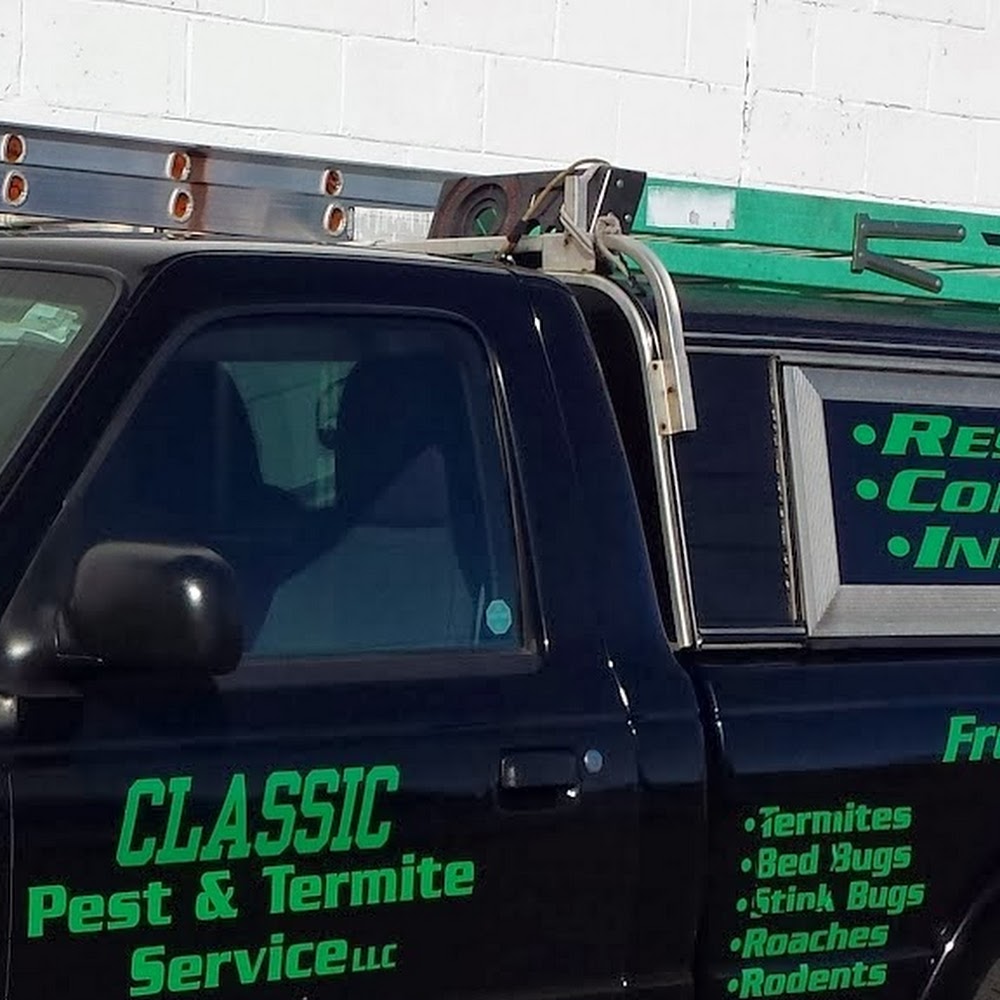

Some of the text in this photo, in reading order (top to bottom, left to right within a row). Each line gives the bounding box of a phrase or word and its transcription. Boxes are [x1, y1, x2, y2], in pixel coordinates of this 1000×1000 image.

[881, 412, 1000, 459] RE
[914, 525, 1000, 569] IN
[942, 714, 1000, 763] Fr
[116, 765, 400, 867] CLASSIC
[759, 802, 912, 838] Termites
[757, 842, 912, 880] Bed Bugs
[27, 853, 475, 938] Pest & Termite
[750, 880, 925, 919] Stink Bugs
[742, 921, 889, 959] Roaches
[129, 932, 398, 997] Service LLC
[739, 961, 888, 999] Rodents
